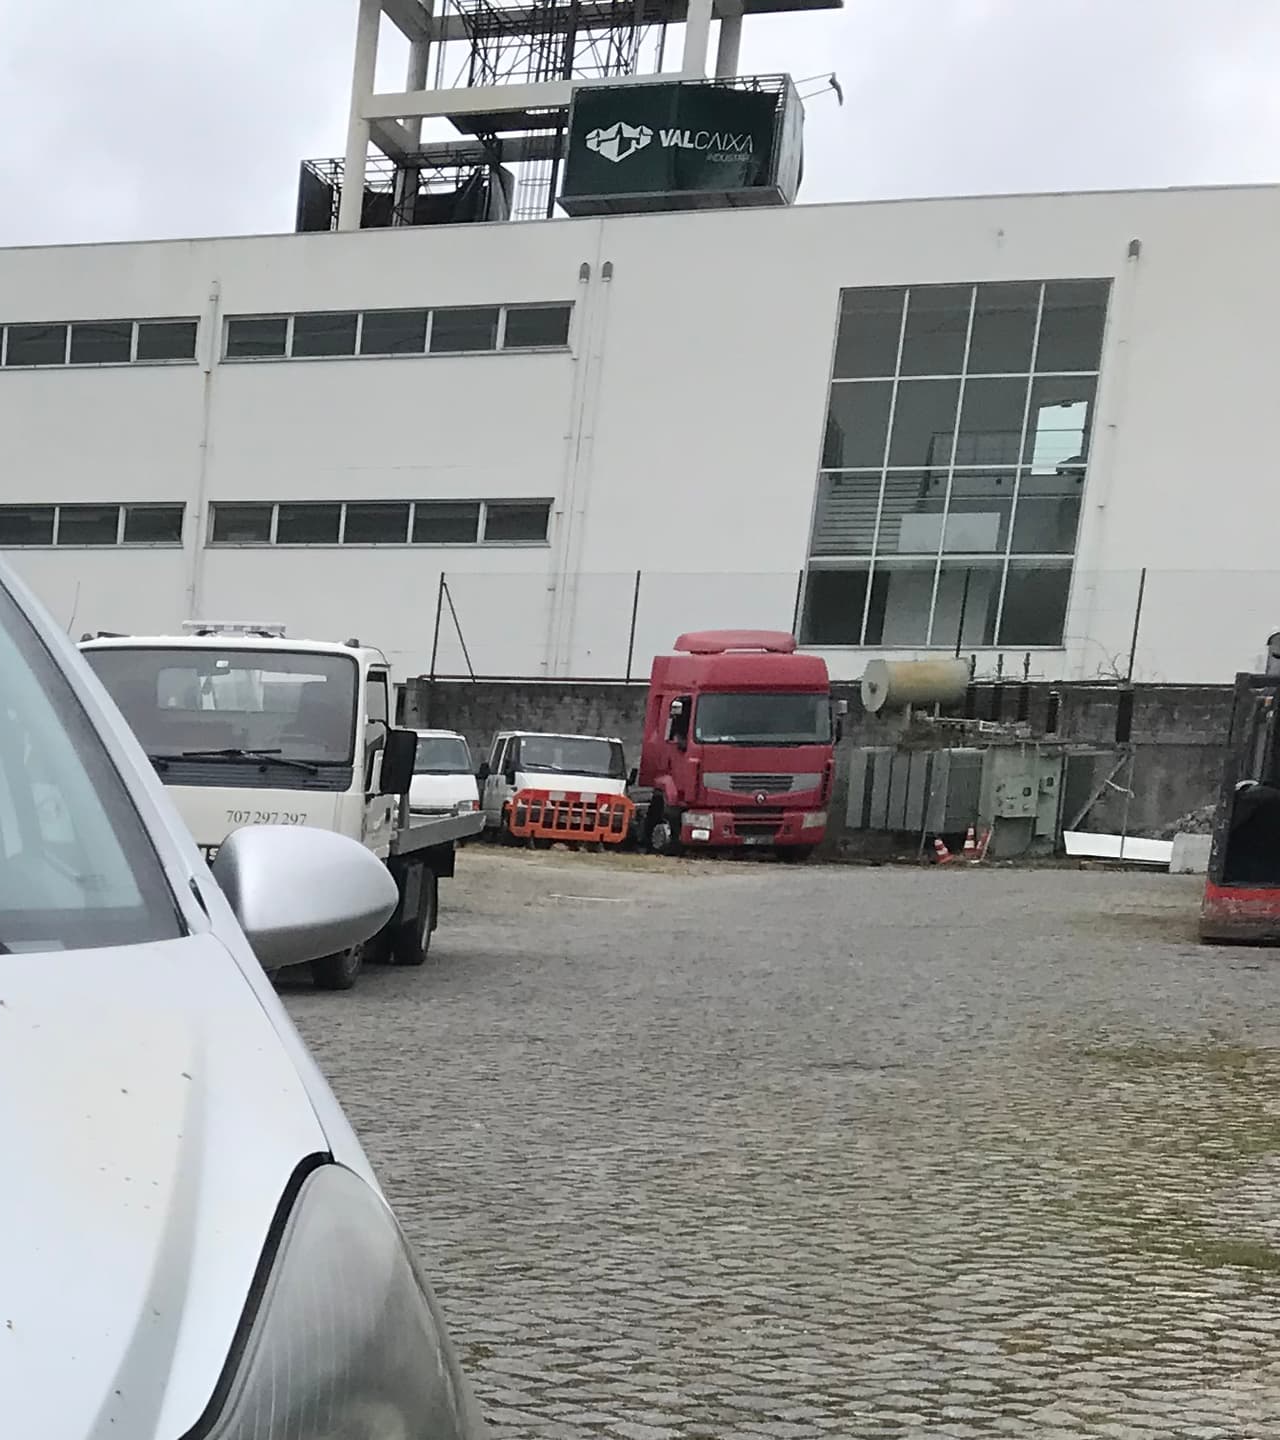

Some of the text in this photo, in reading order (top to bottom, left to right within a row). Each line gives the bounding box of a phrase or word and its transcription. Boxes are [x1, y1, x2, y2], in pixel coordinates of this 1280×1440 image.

[226, 810, 307, 825] 707 297 297
